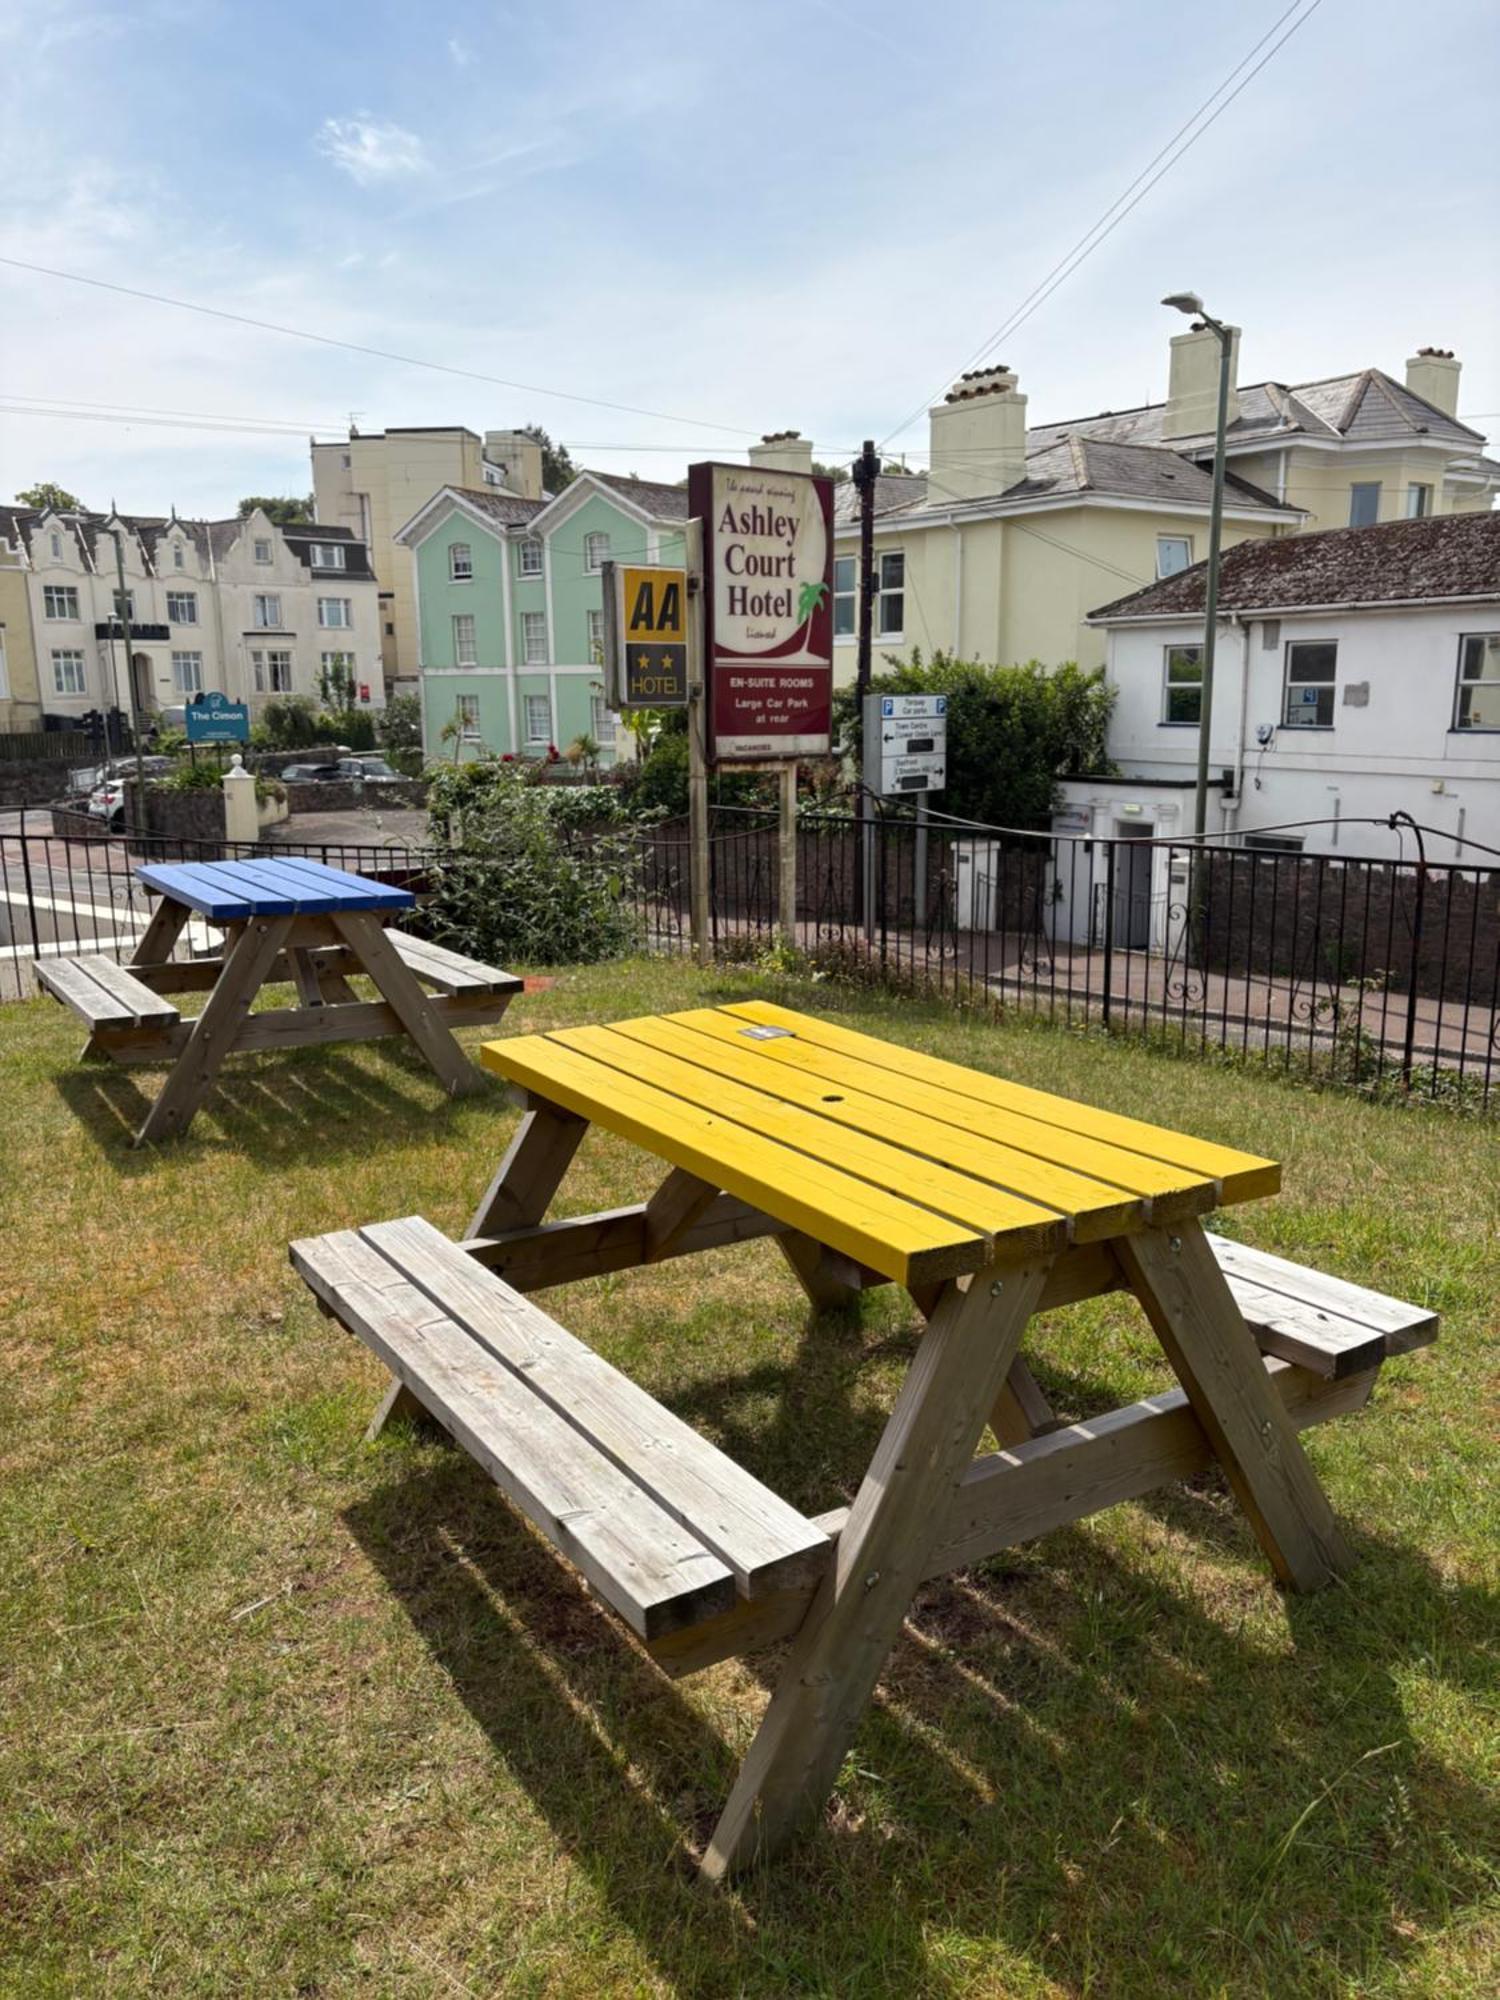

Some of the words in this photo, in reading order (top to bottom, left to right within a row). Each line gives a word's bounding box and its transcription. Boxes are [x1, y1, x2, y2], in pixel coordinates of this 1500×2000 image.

[767, 488, 796, 504] winning
[718, 503, 801, 546] Ashley
[724, 543, 797, 578] Court
[630, 581, 681, 631] AA
[727, 585, 793, 618] Hotel
[631, 676, 683, 695] HOTEL
[729, 677, 776, 688] EN-SUITE
[779, 677, 815, 689] ROOMS
[735, 698, 763, 710] Large
[766, 698, 784, 708] Car
[787, 699, 809, 708] Park
[191, 711, 210, 721] The
[755, 714, 766, 723] at
[770, 714, 790, 724] rear
